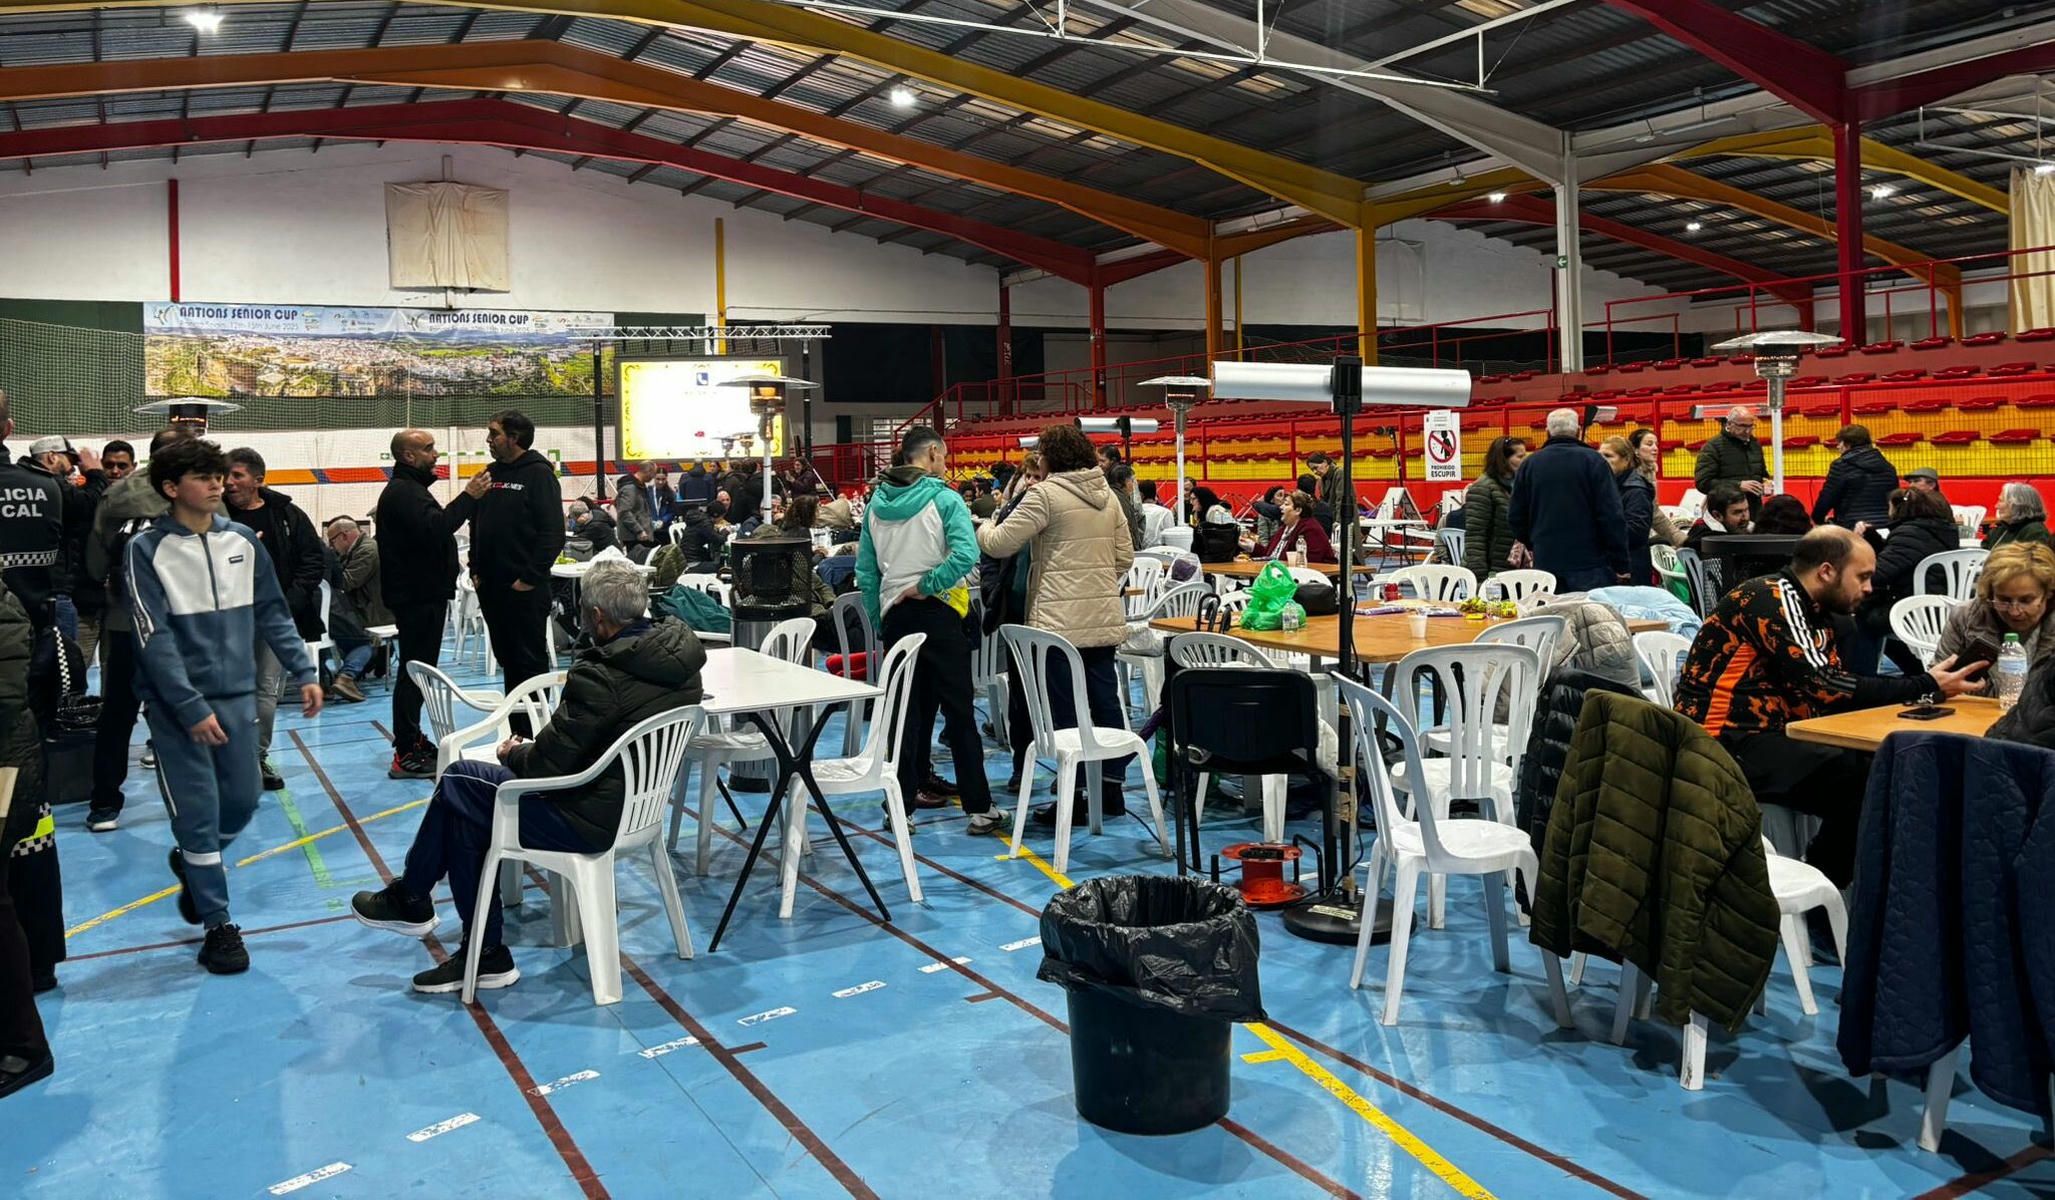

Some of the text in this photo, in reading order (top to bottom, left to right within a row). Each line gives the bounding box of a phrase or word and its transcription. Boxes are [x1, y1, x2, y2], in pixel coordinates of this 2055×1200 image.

[180, 307, 298, 320] NATIONS SENIOR CUP
[429, 312, 529, 325] NATIONS SENIOR CUP
